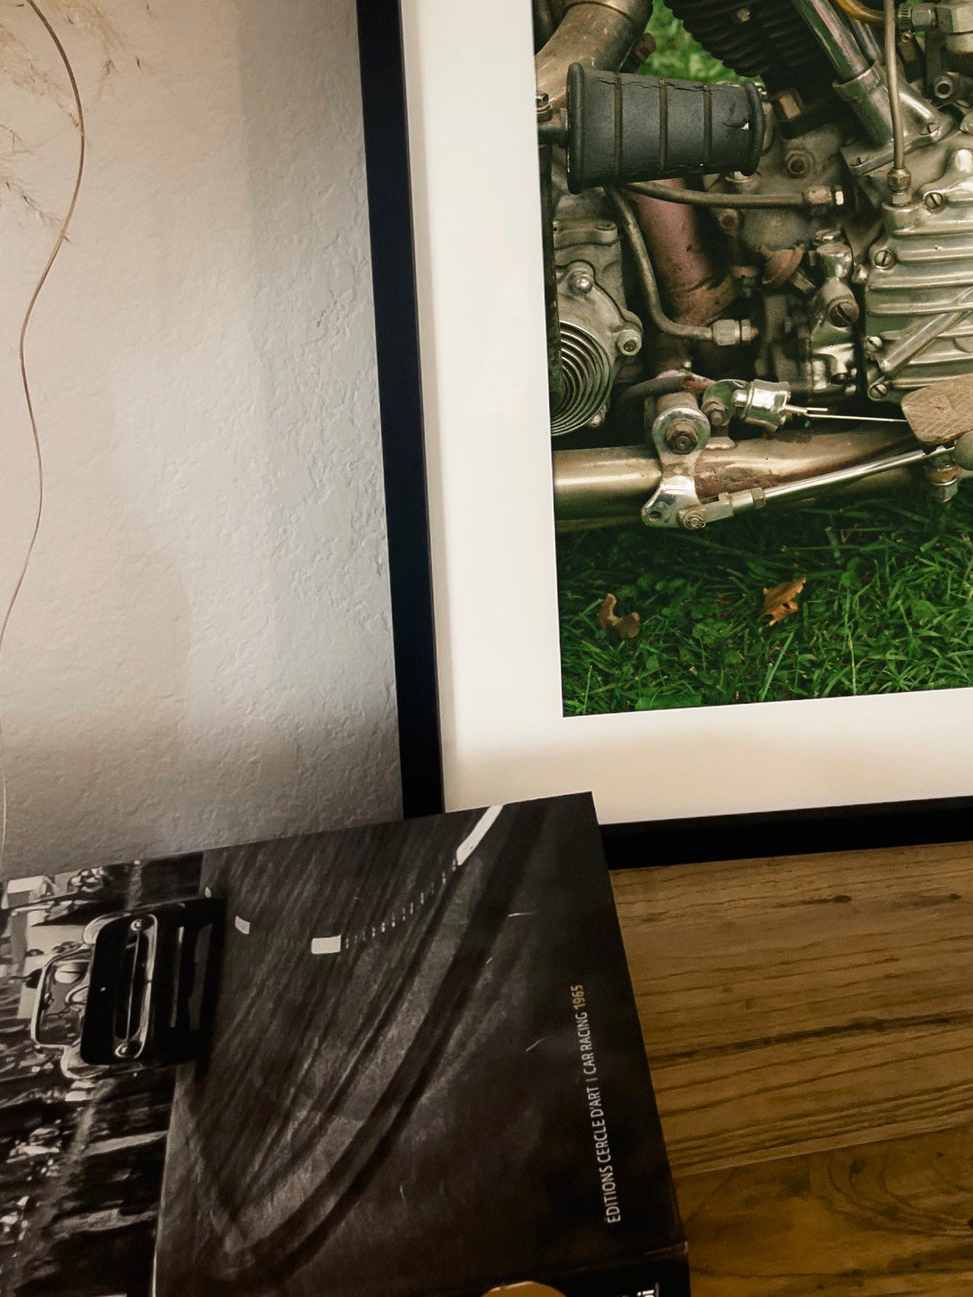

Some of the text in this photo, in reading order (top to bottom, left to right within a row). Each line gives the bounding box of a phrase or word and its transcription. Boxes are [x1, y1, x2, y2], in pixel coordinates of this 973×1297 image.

[570, 984, 586, 1010] 1965
[575, 1012, 593, 1051] RACING
[581, 1052, 597, 1075] CAR
[586, 1086, 605, 1118] D'ART
[592, 1119, 611, 1163] CERCLE
